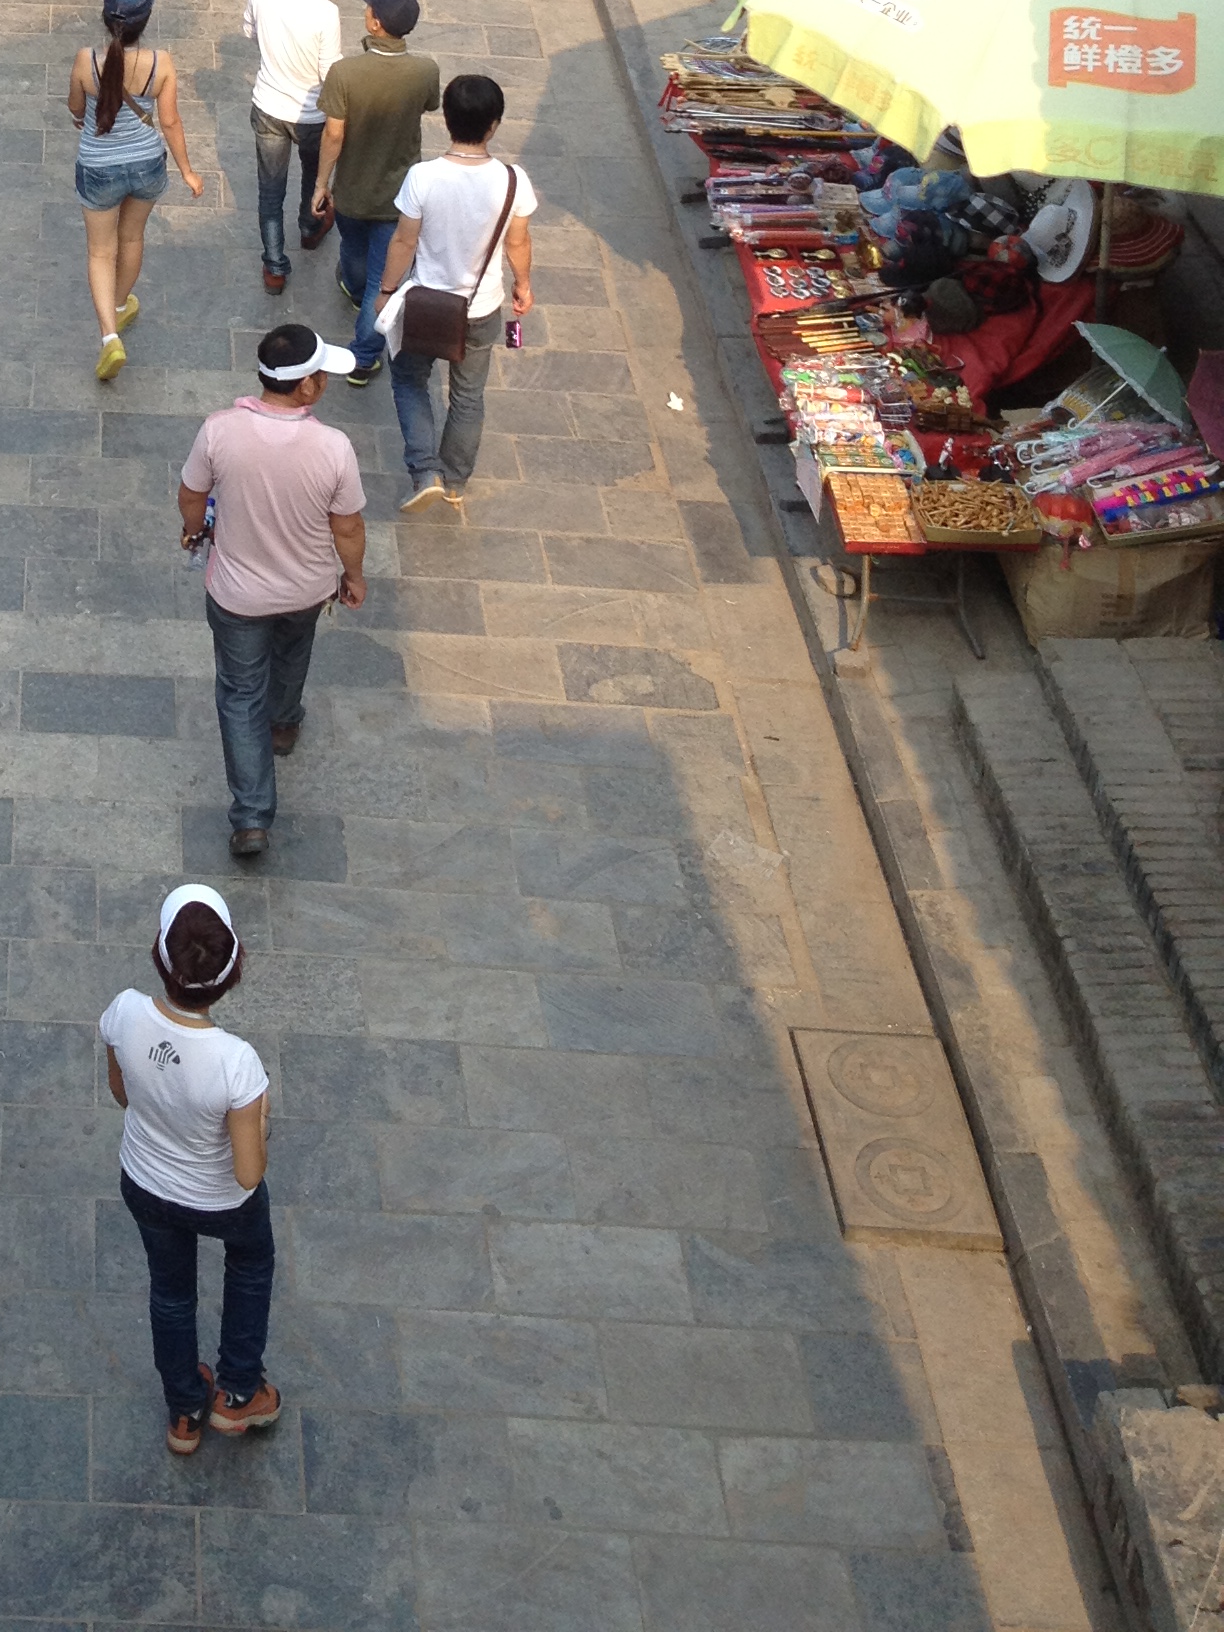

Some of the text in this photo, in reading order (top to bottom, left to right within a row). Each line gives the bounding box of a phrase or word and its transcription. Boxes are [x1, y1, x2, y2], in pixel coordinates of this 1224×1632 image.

[1061, 15, 1138, 42] 统一
[1061, 43, 1185, 77] 鲜橙多
